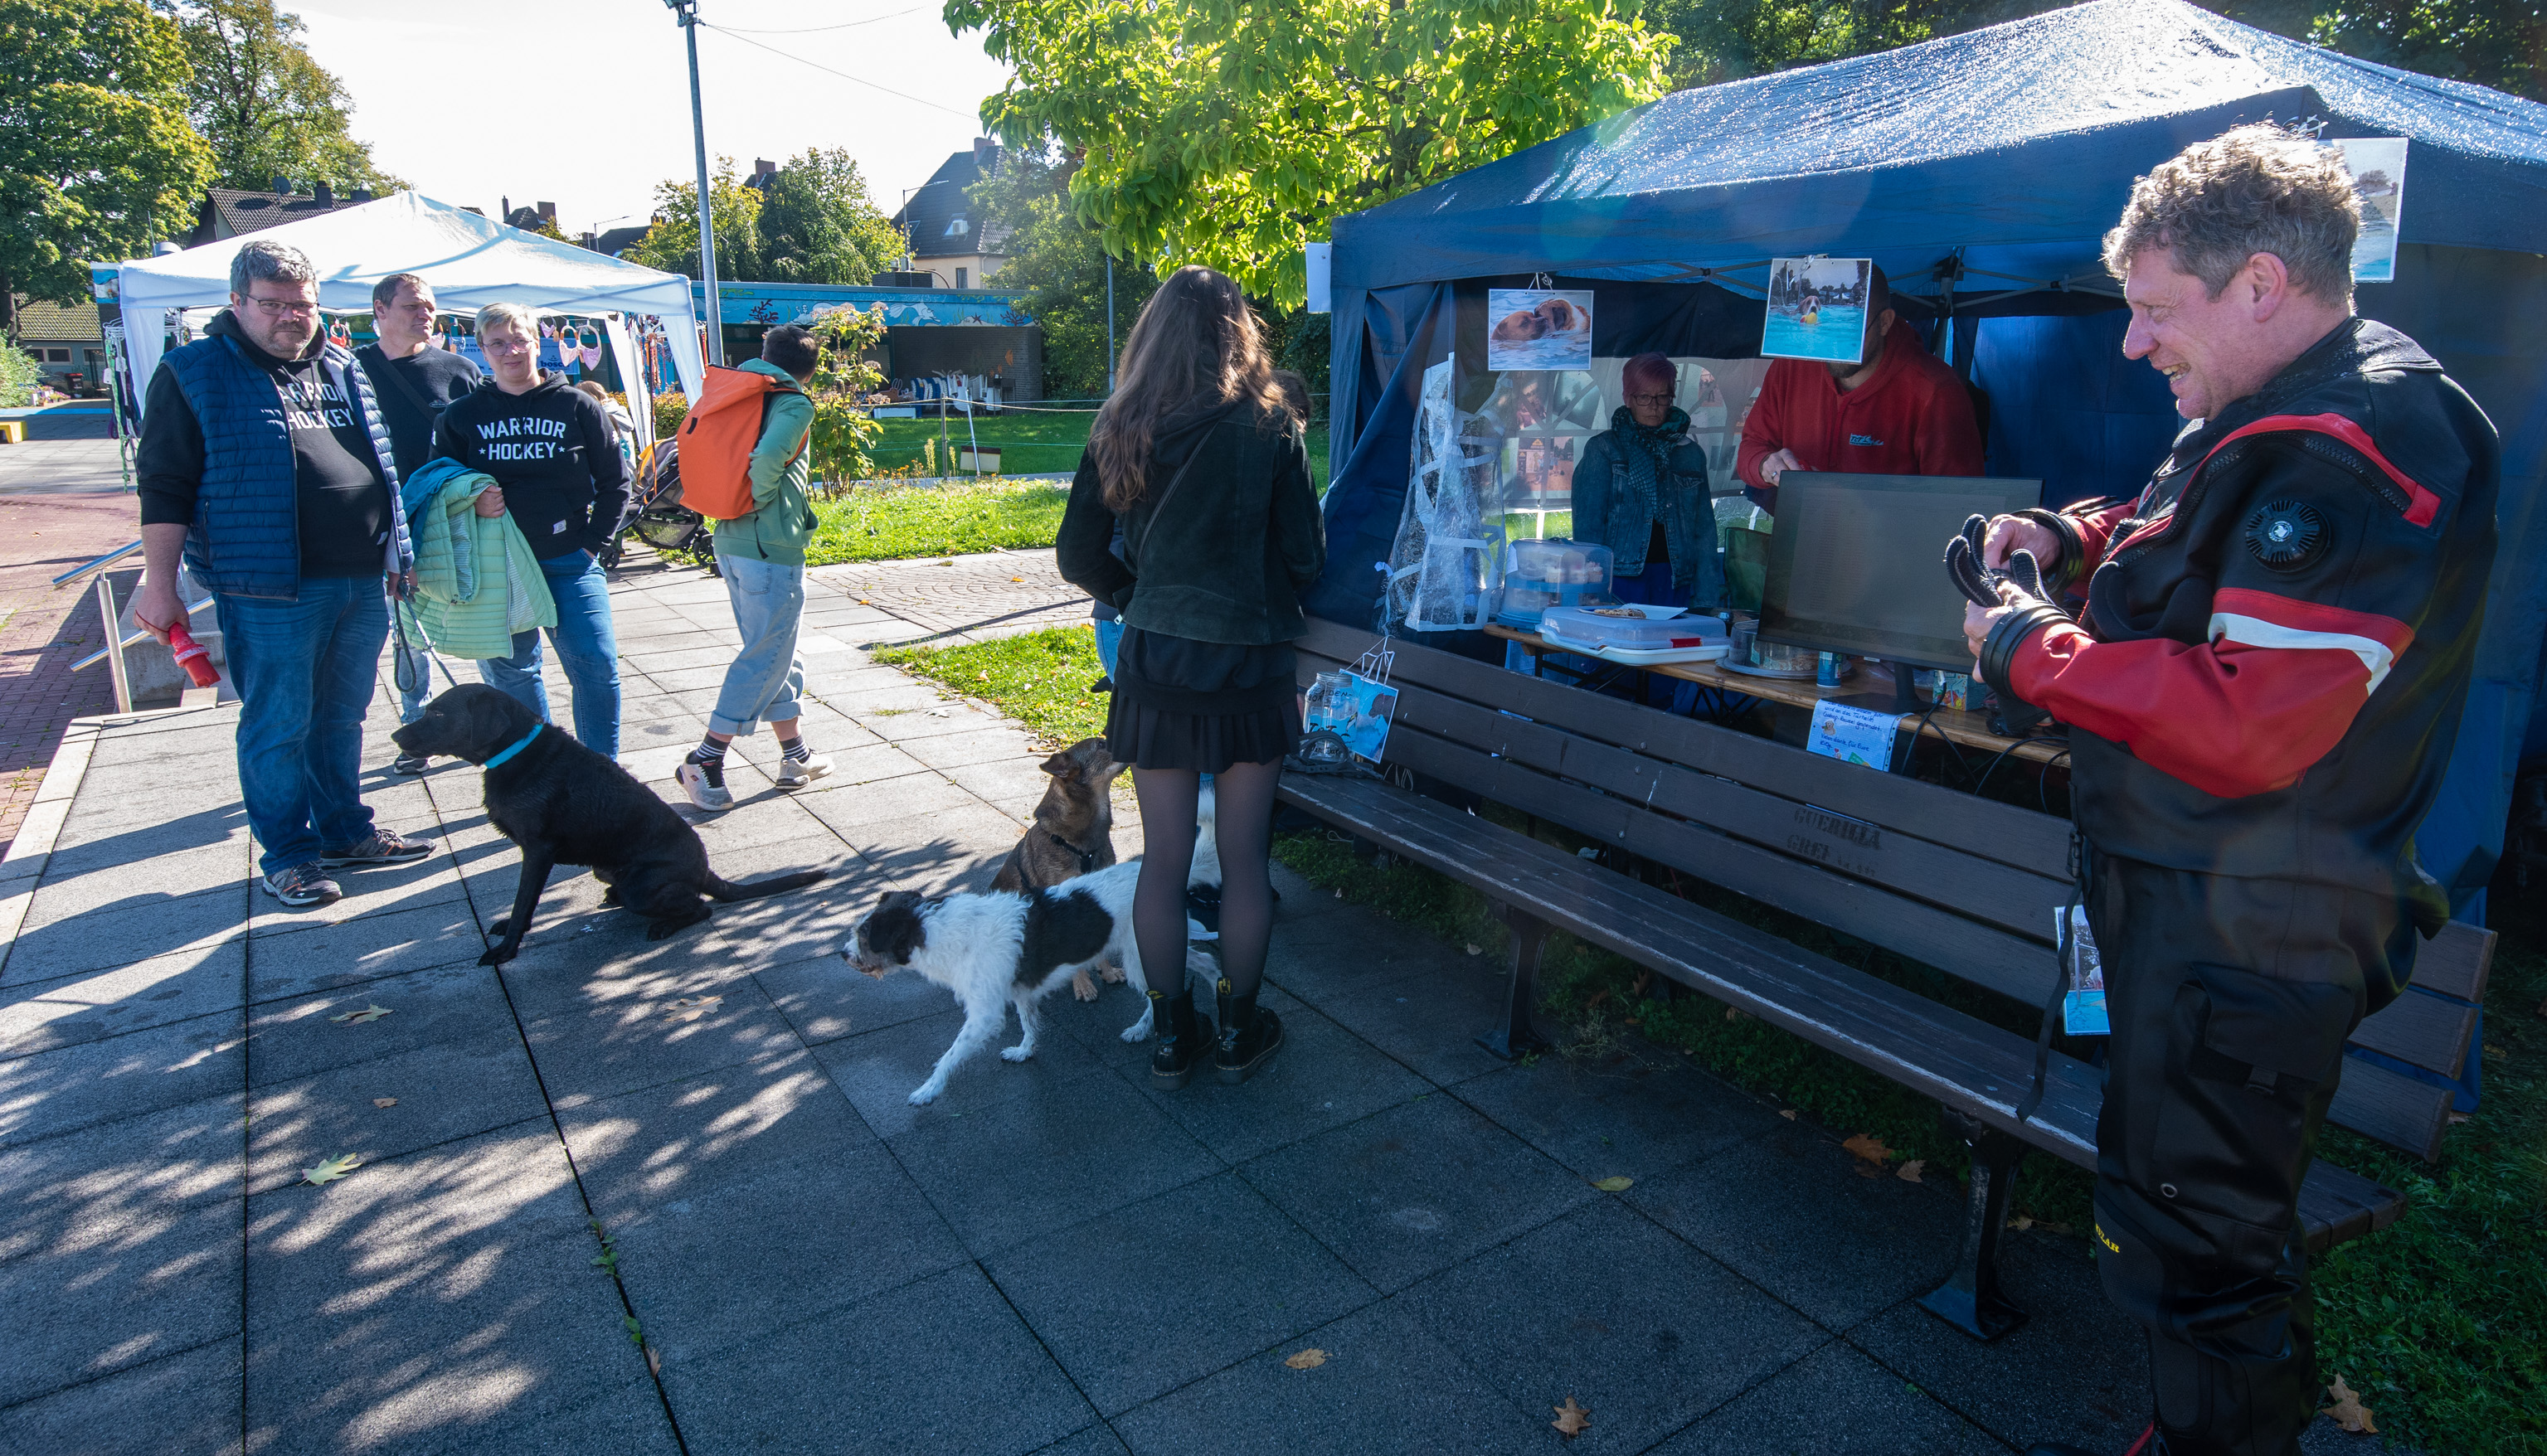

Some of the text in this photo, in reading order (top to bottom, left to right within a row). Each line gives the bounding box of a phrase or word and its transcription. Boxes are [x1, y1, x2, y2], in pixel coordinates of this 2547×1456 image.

[276, 381, 345, 405] ARRIO
[287, 408, 355, 430] HOCKEY
[476, 416, 566, 439] WARRIOR
[488, 441, 557, 461] HOCKEY
